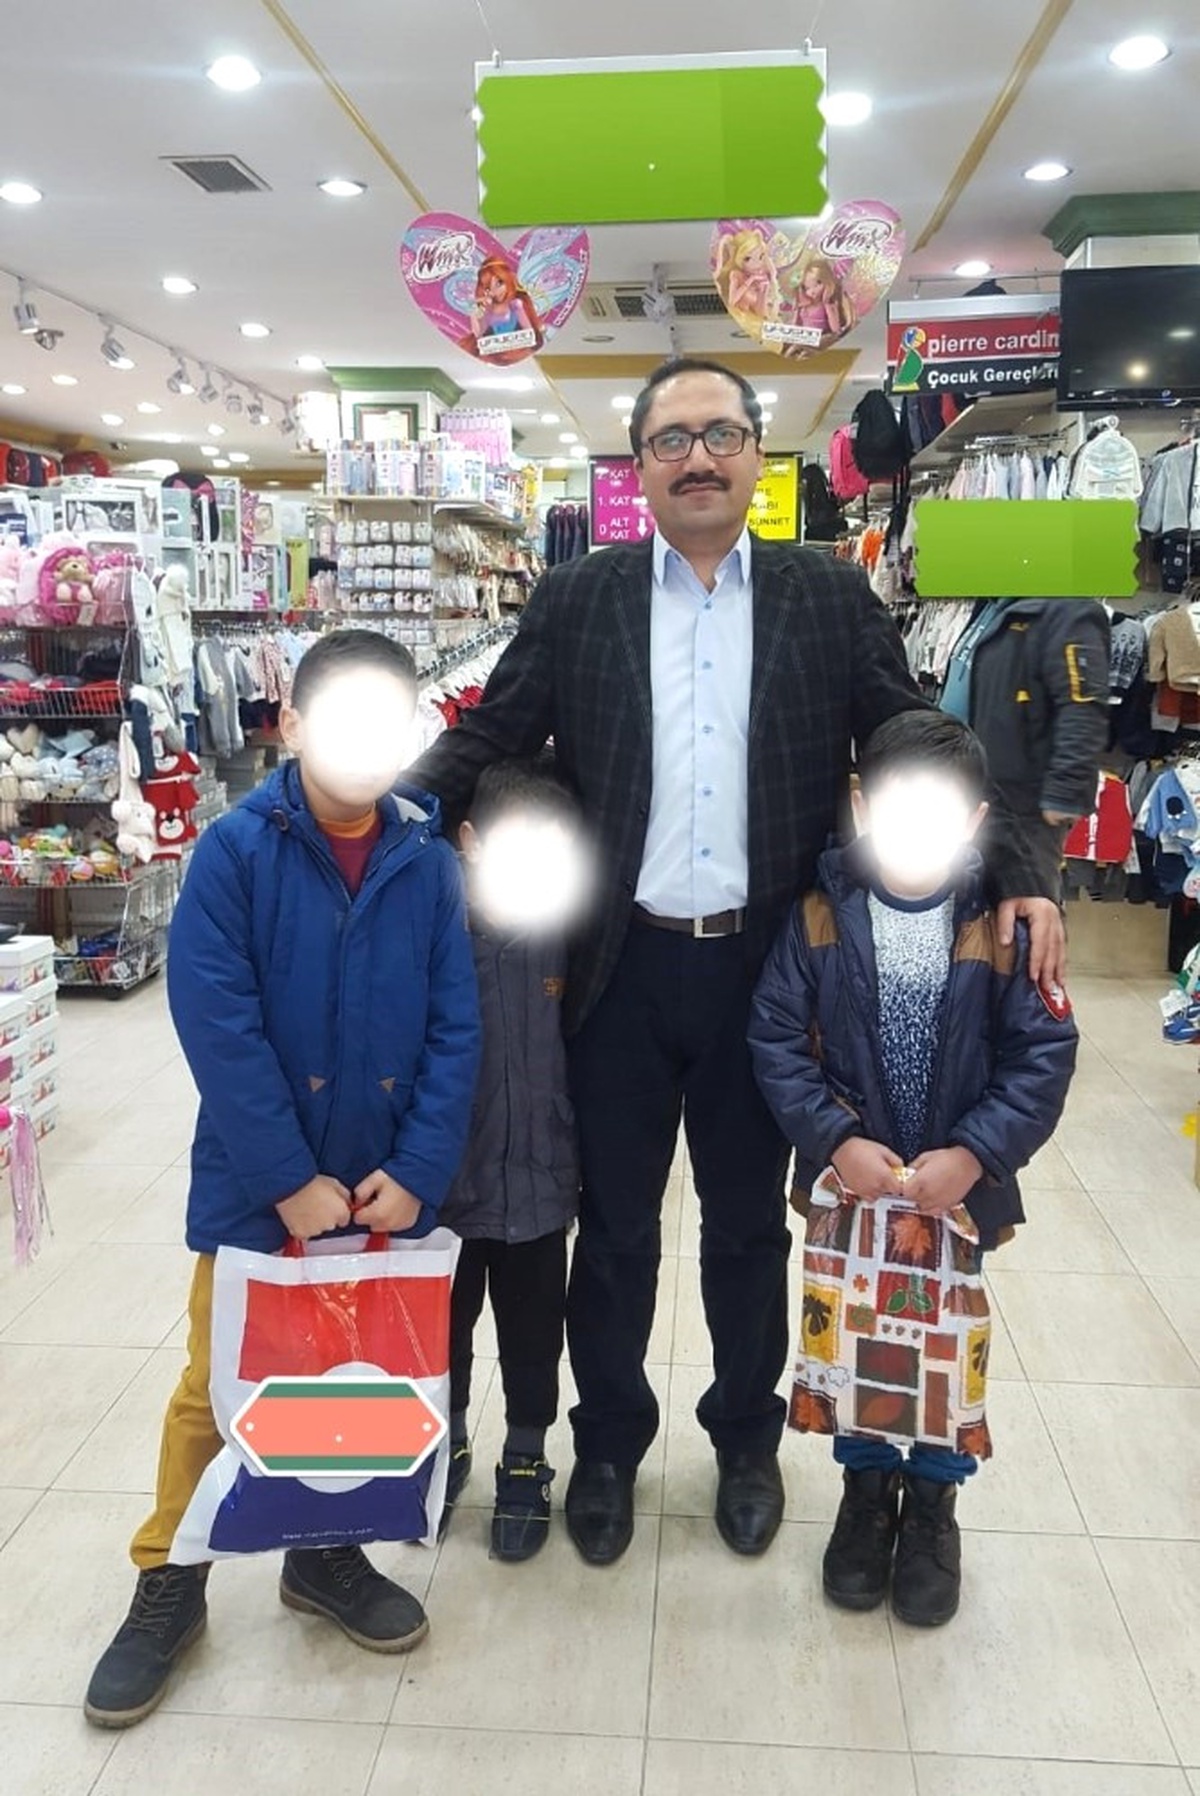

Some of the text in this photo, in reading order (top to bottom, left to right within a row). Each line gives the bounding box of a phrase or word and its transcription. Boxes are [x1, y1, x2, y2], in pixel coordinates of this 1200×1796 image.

[928, 330, 1060, 359] pierre cardin
[928, 370, 979, 389] Çocuk
[609, 469, 631, 480] KAT
[609, 496, 631, 507] KAT
[610, 517, 629, 527] ALT
[610, 530, 631, 540] KAT
